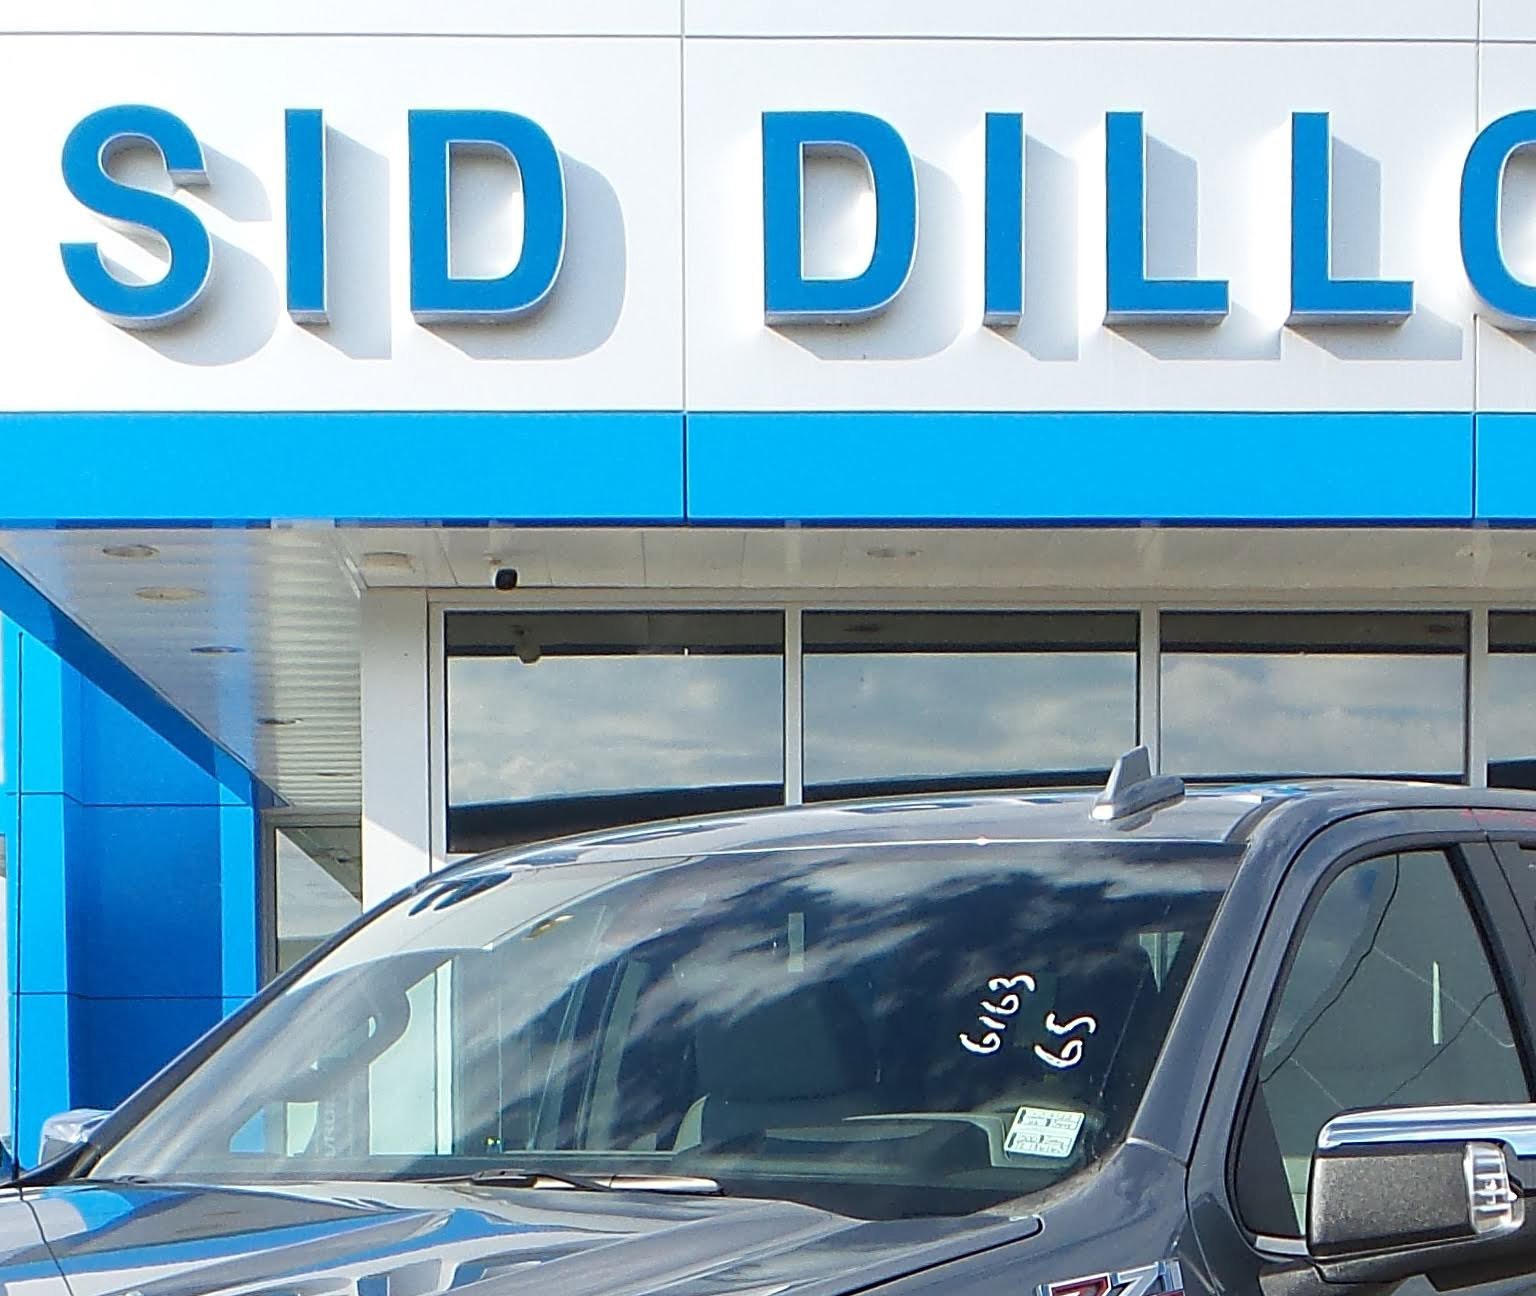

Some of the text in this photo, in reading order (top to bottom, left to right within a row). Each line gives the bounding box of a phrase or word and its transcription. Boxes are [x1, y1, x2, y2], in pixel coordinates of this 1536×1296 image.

[60, 104, 568, 324] SID
[959, 973, 1036, 1055] 6163
[1034, 1012, 1097, 1069] 65
